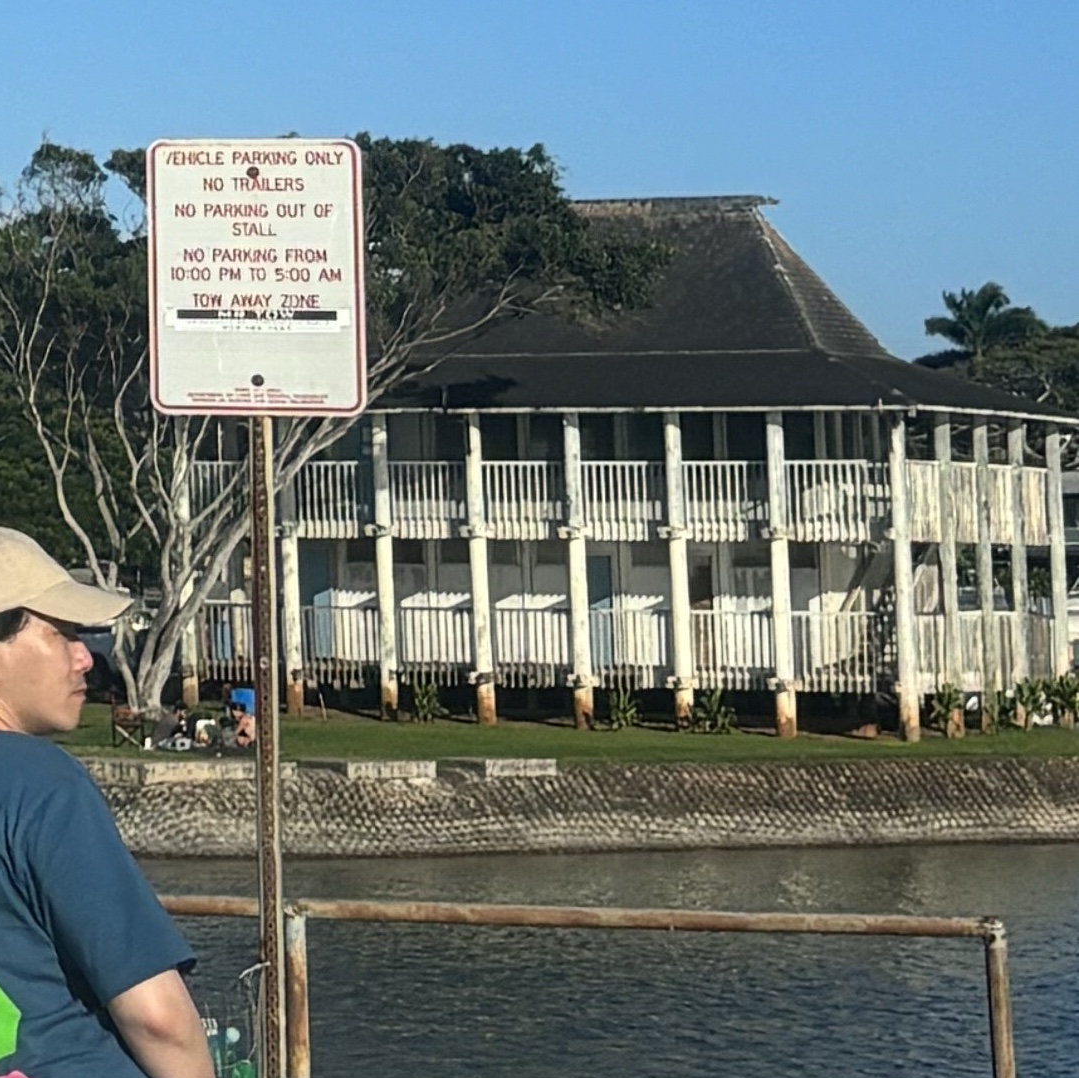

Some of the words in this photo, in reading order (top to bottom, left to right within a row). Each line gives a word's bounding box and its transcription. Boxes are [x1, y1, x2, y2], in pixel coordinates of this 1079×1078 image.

[232, 151, 297, 166] PARKING
[305, 151, 344, 166] ONLY
[203, 177, 224, 191] NO
[231, 177, 305, 192] TRAILERS
[174, 203, 196, 218] NO
[204, 203, 269, 218] PARKING
[276, 203, 306, 218] OUT
[314, 203, 333, 218] OF
[232, 222, 277, 237] STALL
[183, 248, 205, 263] NO
[212, 248, 278, 263] PARKING
[285, 248, 328, 263] FROM
[171, 266, 211, 282] 10:00
[219, 266, 241, 282] PM
[249, 266, 267, 282] TO
[275, 267, 311, 283] 5:00
[318, 267, 342, 282] AM
[192, 293, 222, 308] TOW
[231, 293, 273, 308] AWAY
[281, 294, 320, 309] ZONE
